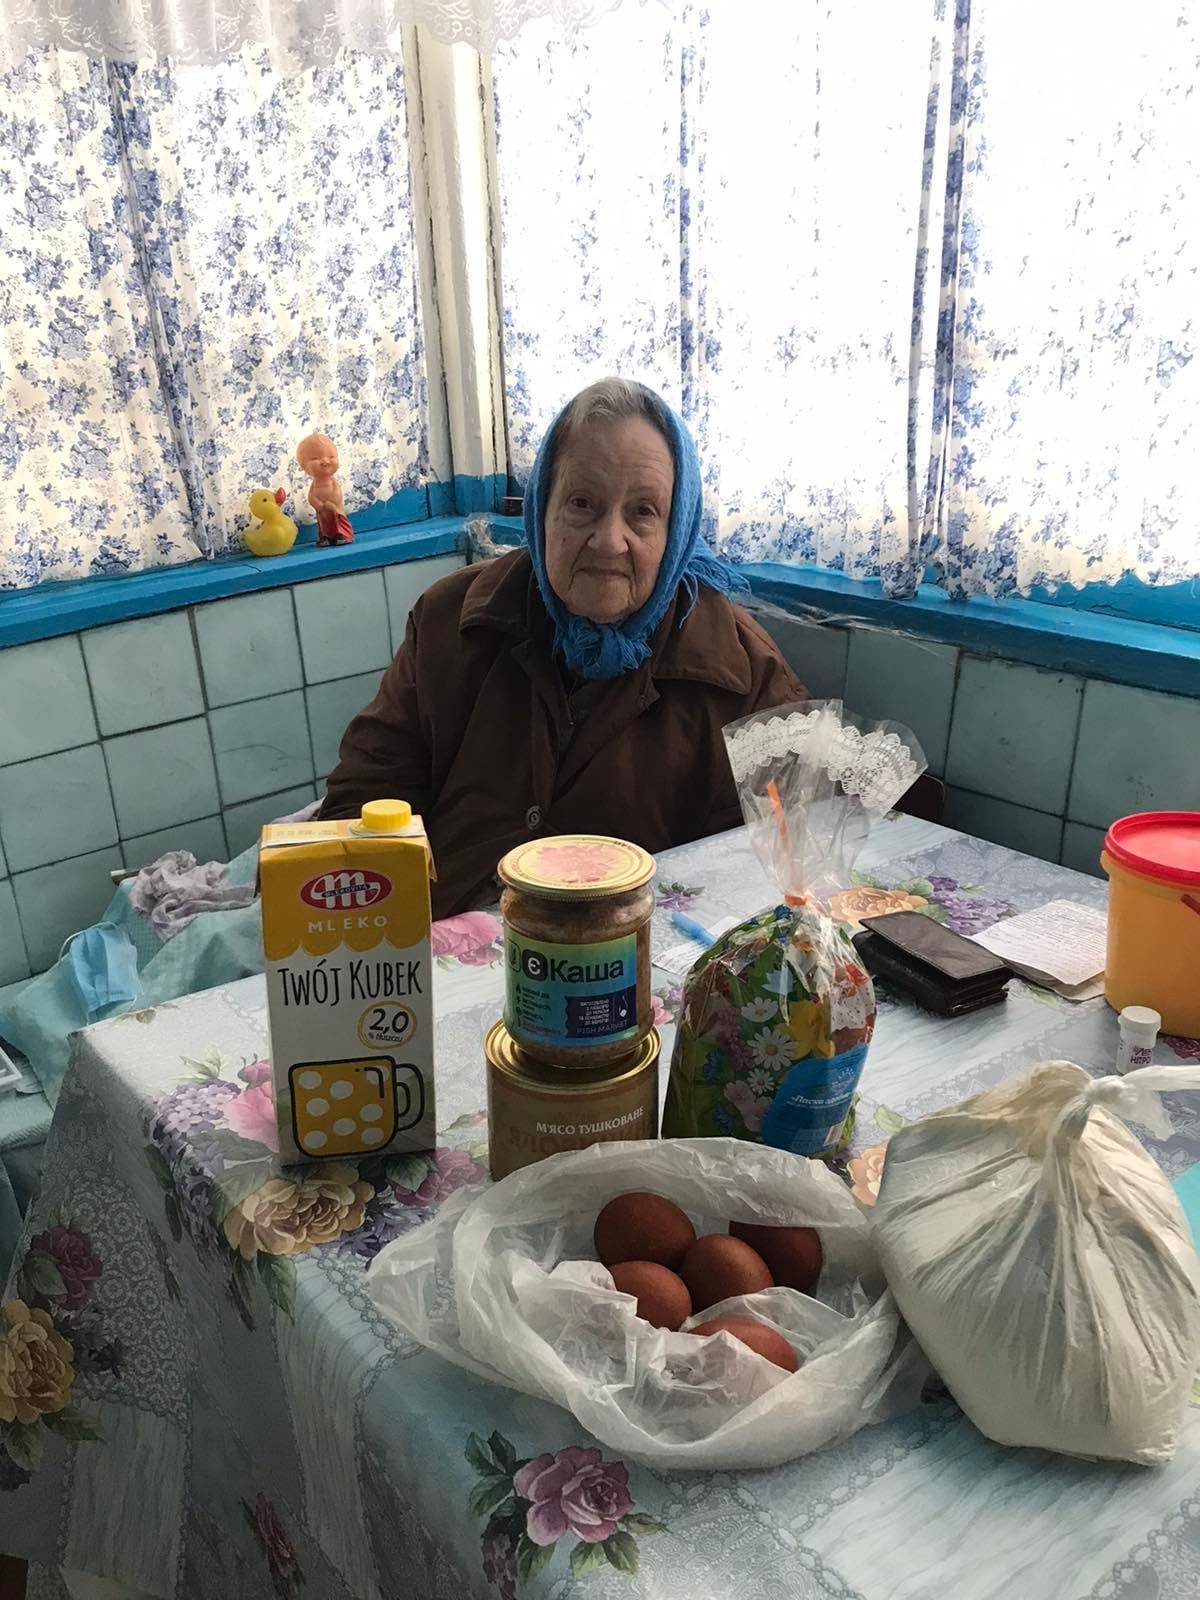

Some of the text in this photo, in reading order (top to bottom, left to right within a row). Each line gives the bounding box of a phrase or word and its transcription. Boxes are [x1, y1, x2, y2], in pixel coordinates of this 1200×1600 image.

[307, 914, 388, 934] MLEKO
[277, 959, 423, 1006] TWÓJ KUBEK
[550, 958, 624, 984] Каша
[369, 1008, 409, 1034] 2,0
[578, 1105, 644, 1135] ТУШКОВАНЕ
